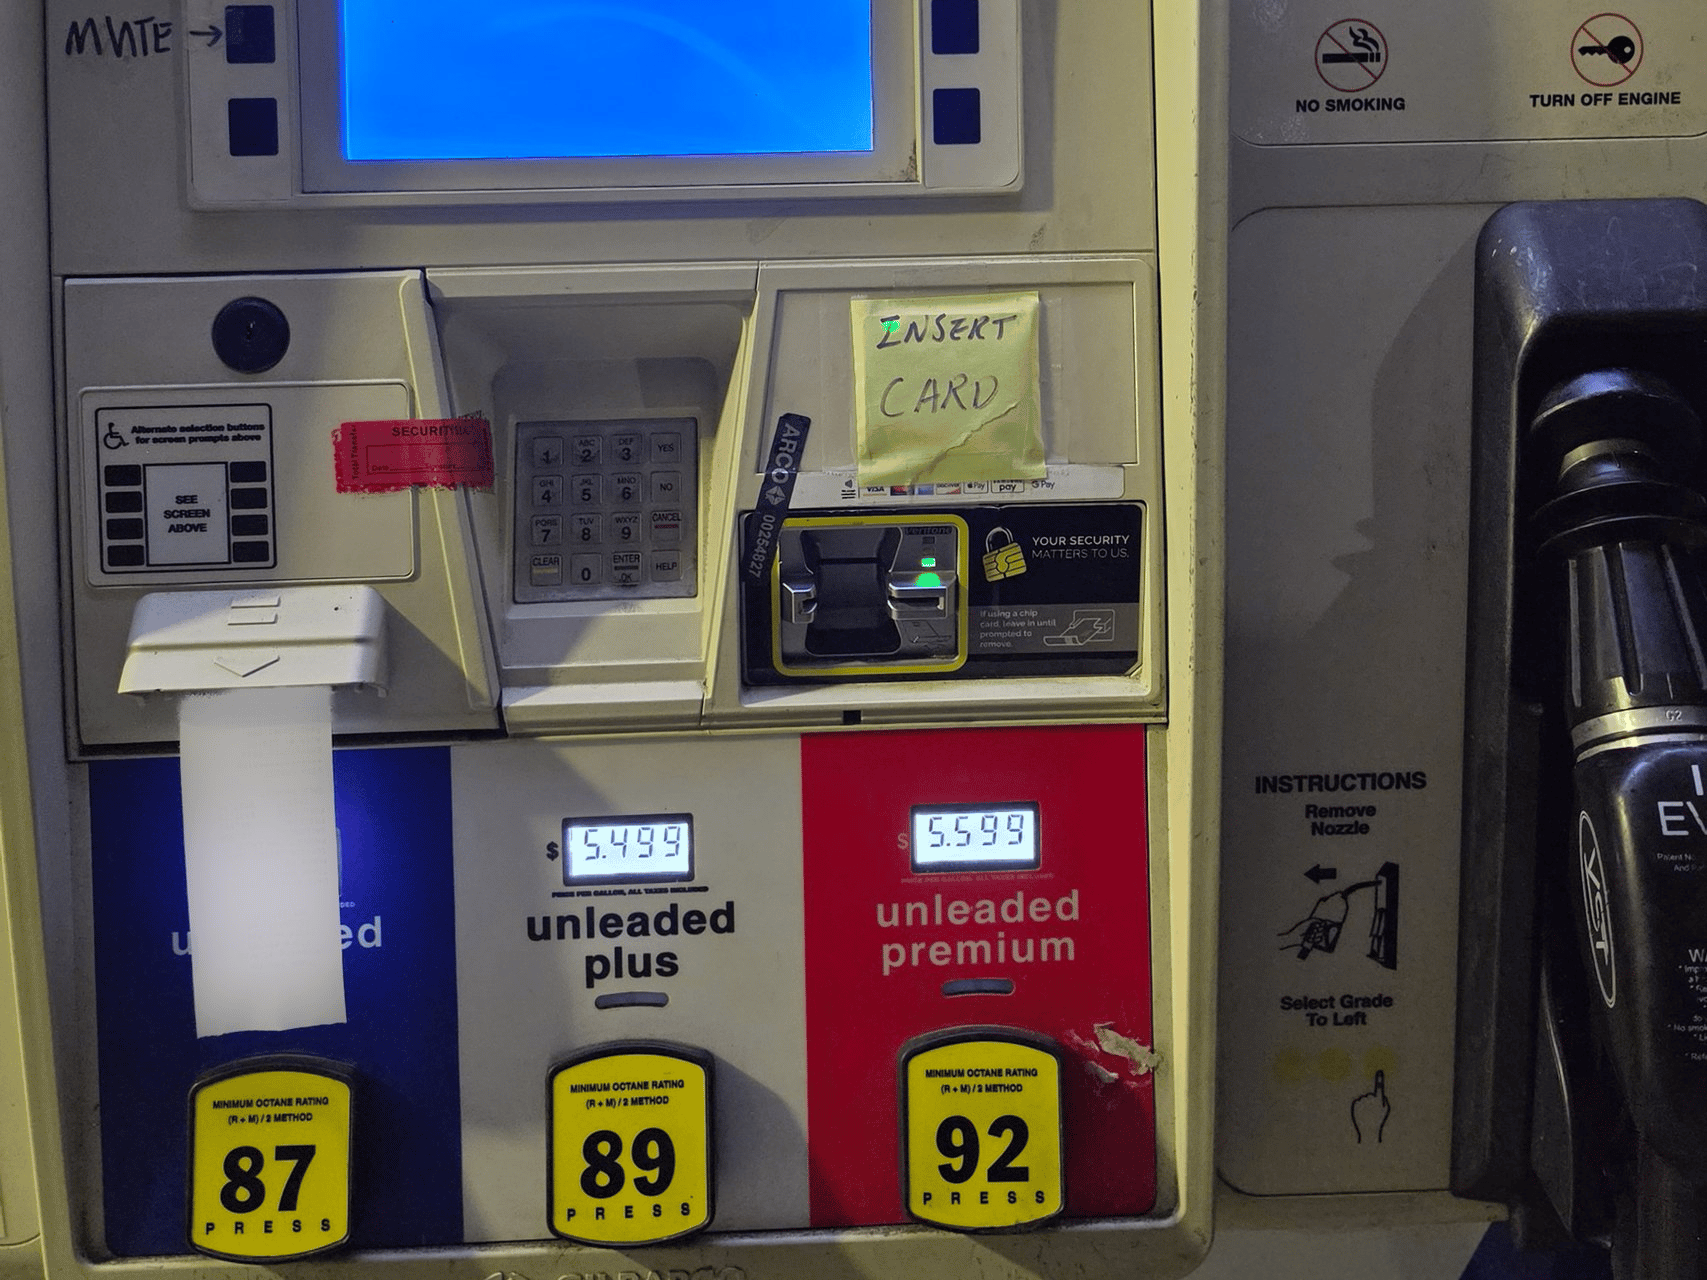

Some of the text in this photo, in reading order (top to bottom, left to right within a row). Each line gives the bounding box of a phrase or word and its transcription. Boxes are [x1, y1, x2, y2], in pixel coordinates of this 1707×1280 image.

[1295, 97, 1405, 112] NO SMOKING
[1529, 92, 1681, 107] TURN OFF ENGINE
[876, 313, 1018, 350] INSERT
[880, 372, 998, 418] CARD
[130, 422, 265, 433] Alternate selection buttons
[135, 436, 150, 444] for
[188, 434, 229, 444] prompts
[231, 433, 261, 441] above
[658, 443, 674, 452] YES
[771, 422, 800, 485] ARCO
[541, 448, 632, 464] 1 2 3
[660, 482, 673, 492] NO
[174, 495, 198, 504] SEE
[542, 487, 632, 503] 4 5 6
[163, 508, 211, 518] SCREEN
[652, 512, 682, 522] CANCEL
[167, 523, 207, 532] ABOVE
[541, 526, 631, 543] 7 8 9
[749, 514, 776, 578] 00254827
[1032, 535, 1129, 545] YOUR SECURITY
[613, 553, 641, 564] ENTER
[1032, 548, 1129, 558] MATTERS TO US.
[532, 556, 560, 567] CLEAR
[655, 561, 678, 571] HELP
[581, 567, 591, 581] 0
[1254, 771, 1427, 793] INSTRUCTIONS
[1304, 803, 1377, 818] Remove
[897, 814, 1024, 850] $ 5.599
[1310, 820, 1370, 835] Nozzle
[546, 825, 681, 862] $ 5.499
[876, 889, 1080, 929] unleaded
[526, 900, 736, 942] unleaded
[881, 933, 1077, 976] premium
[584, 946, 680, 988] plus
[1280, 993, 1393, 1010] Select Grade
[1305, 1011, 1367, 1026] To Left
[925, 1068, 1038, 1077] MINIMUM OCTANE RATING
[570, 1079, 684, 1092] MINIMUM OCTANE RATING
[212, 1096, 328, 1108] MINIMUM OCTANE RATING
[935, 1114, 1029, 1184] 92
[579, 1127, 676, 1199] 89
[220, 1145, 316, 1214] 87
